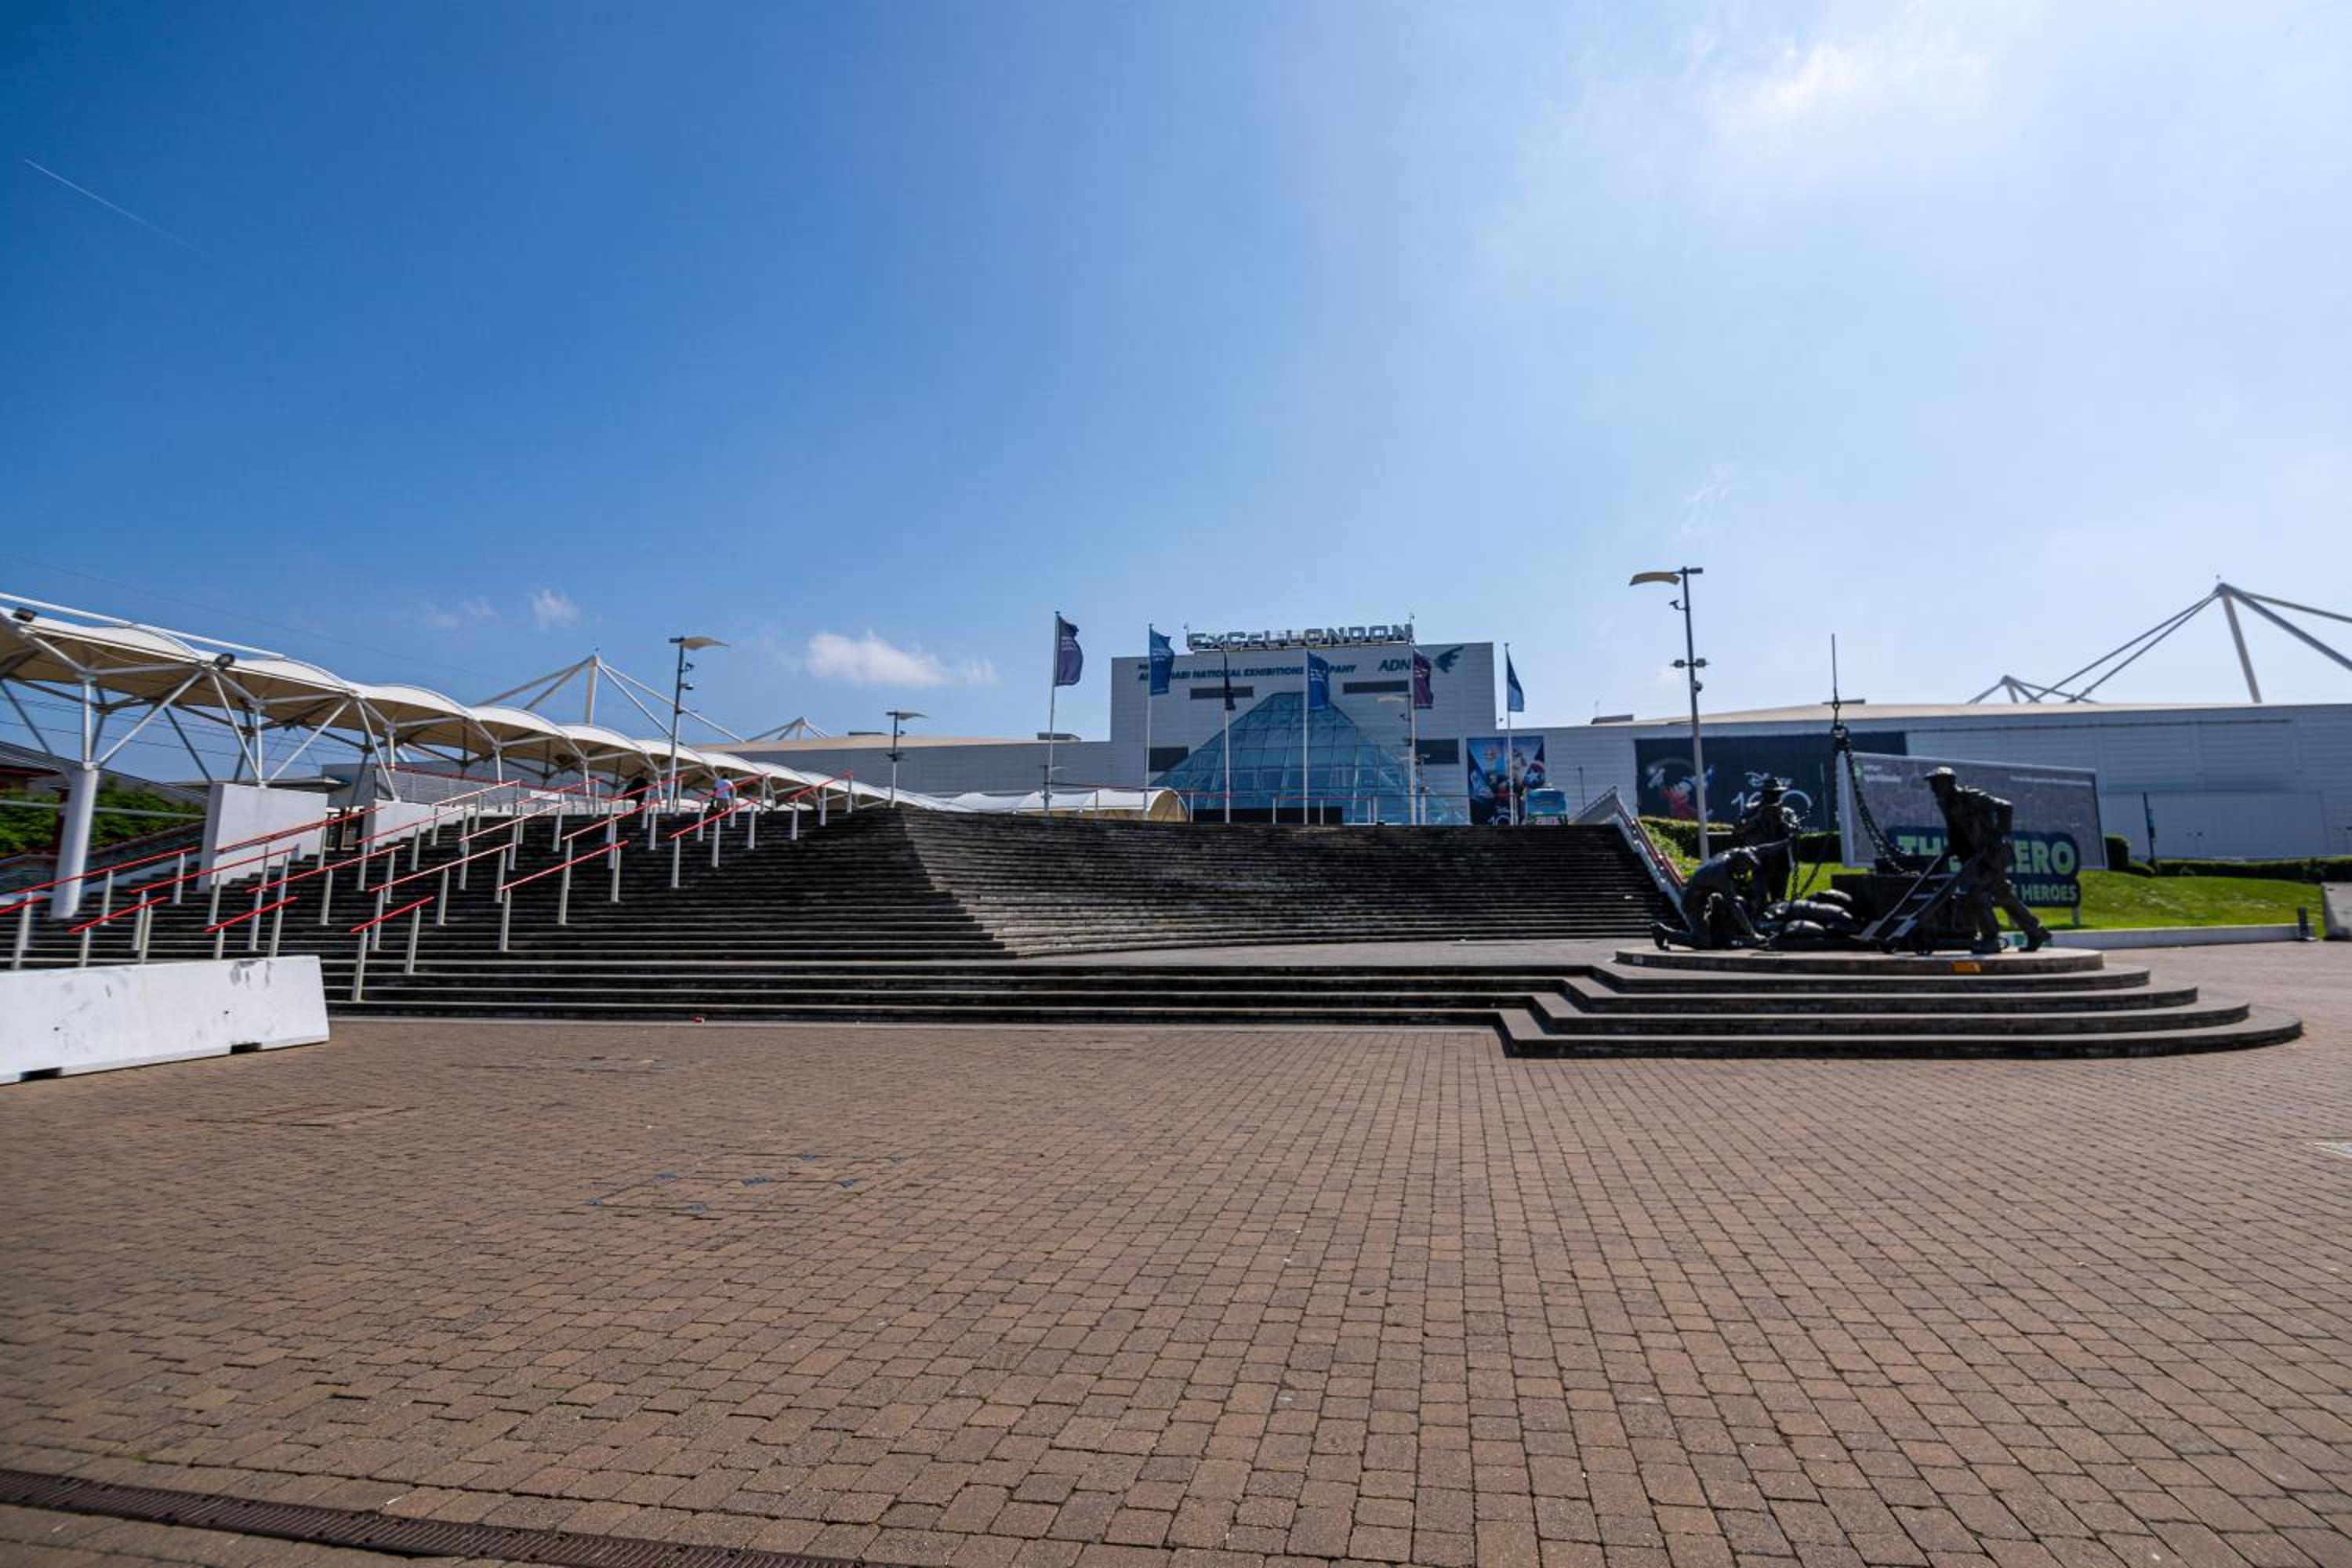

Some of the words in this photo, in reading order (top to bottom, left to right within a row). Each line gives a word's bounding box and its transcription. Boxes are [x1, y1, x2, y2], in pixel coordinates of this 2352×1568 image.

[1286, 624, 1413, 646] LONDON
[1378, 659, 1412, 672] ADN
[2006, 840, 2075, 875] ERO
[2021, 884, 2077, 902] HEROES
